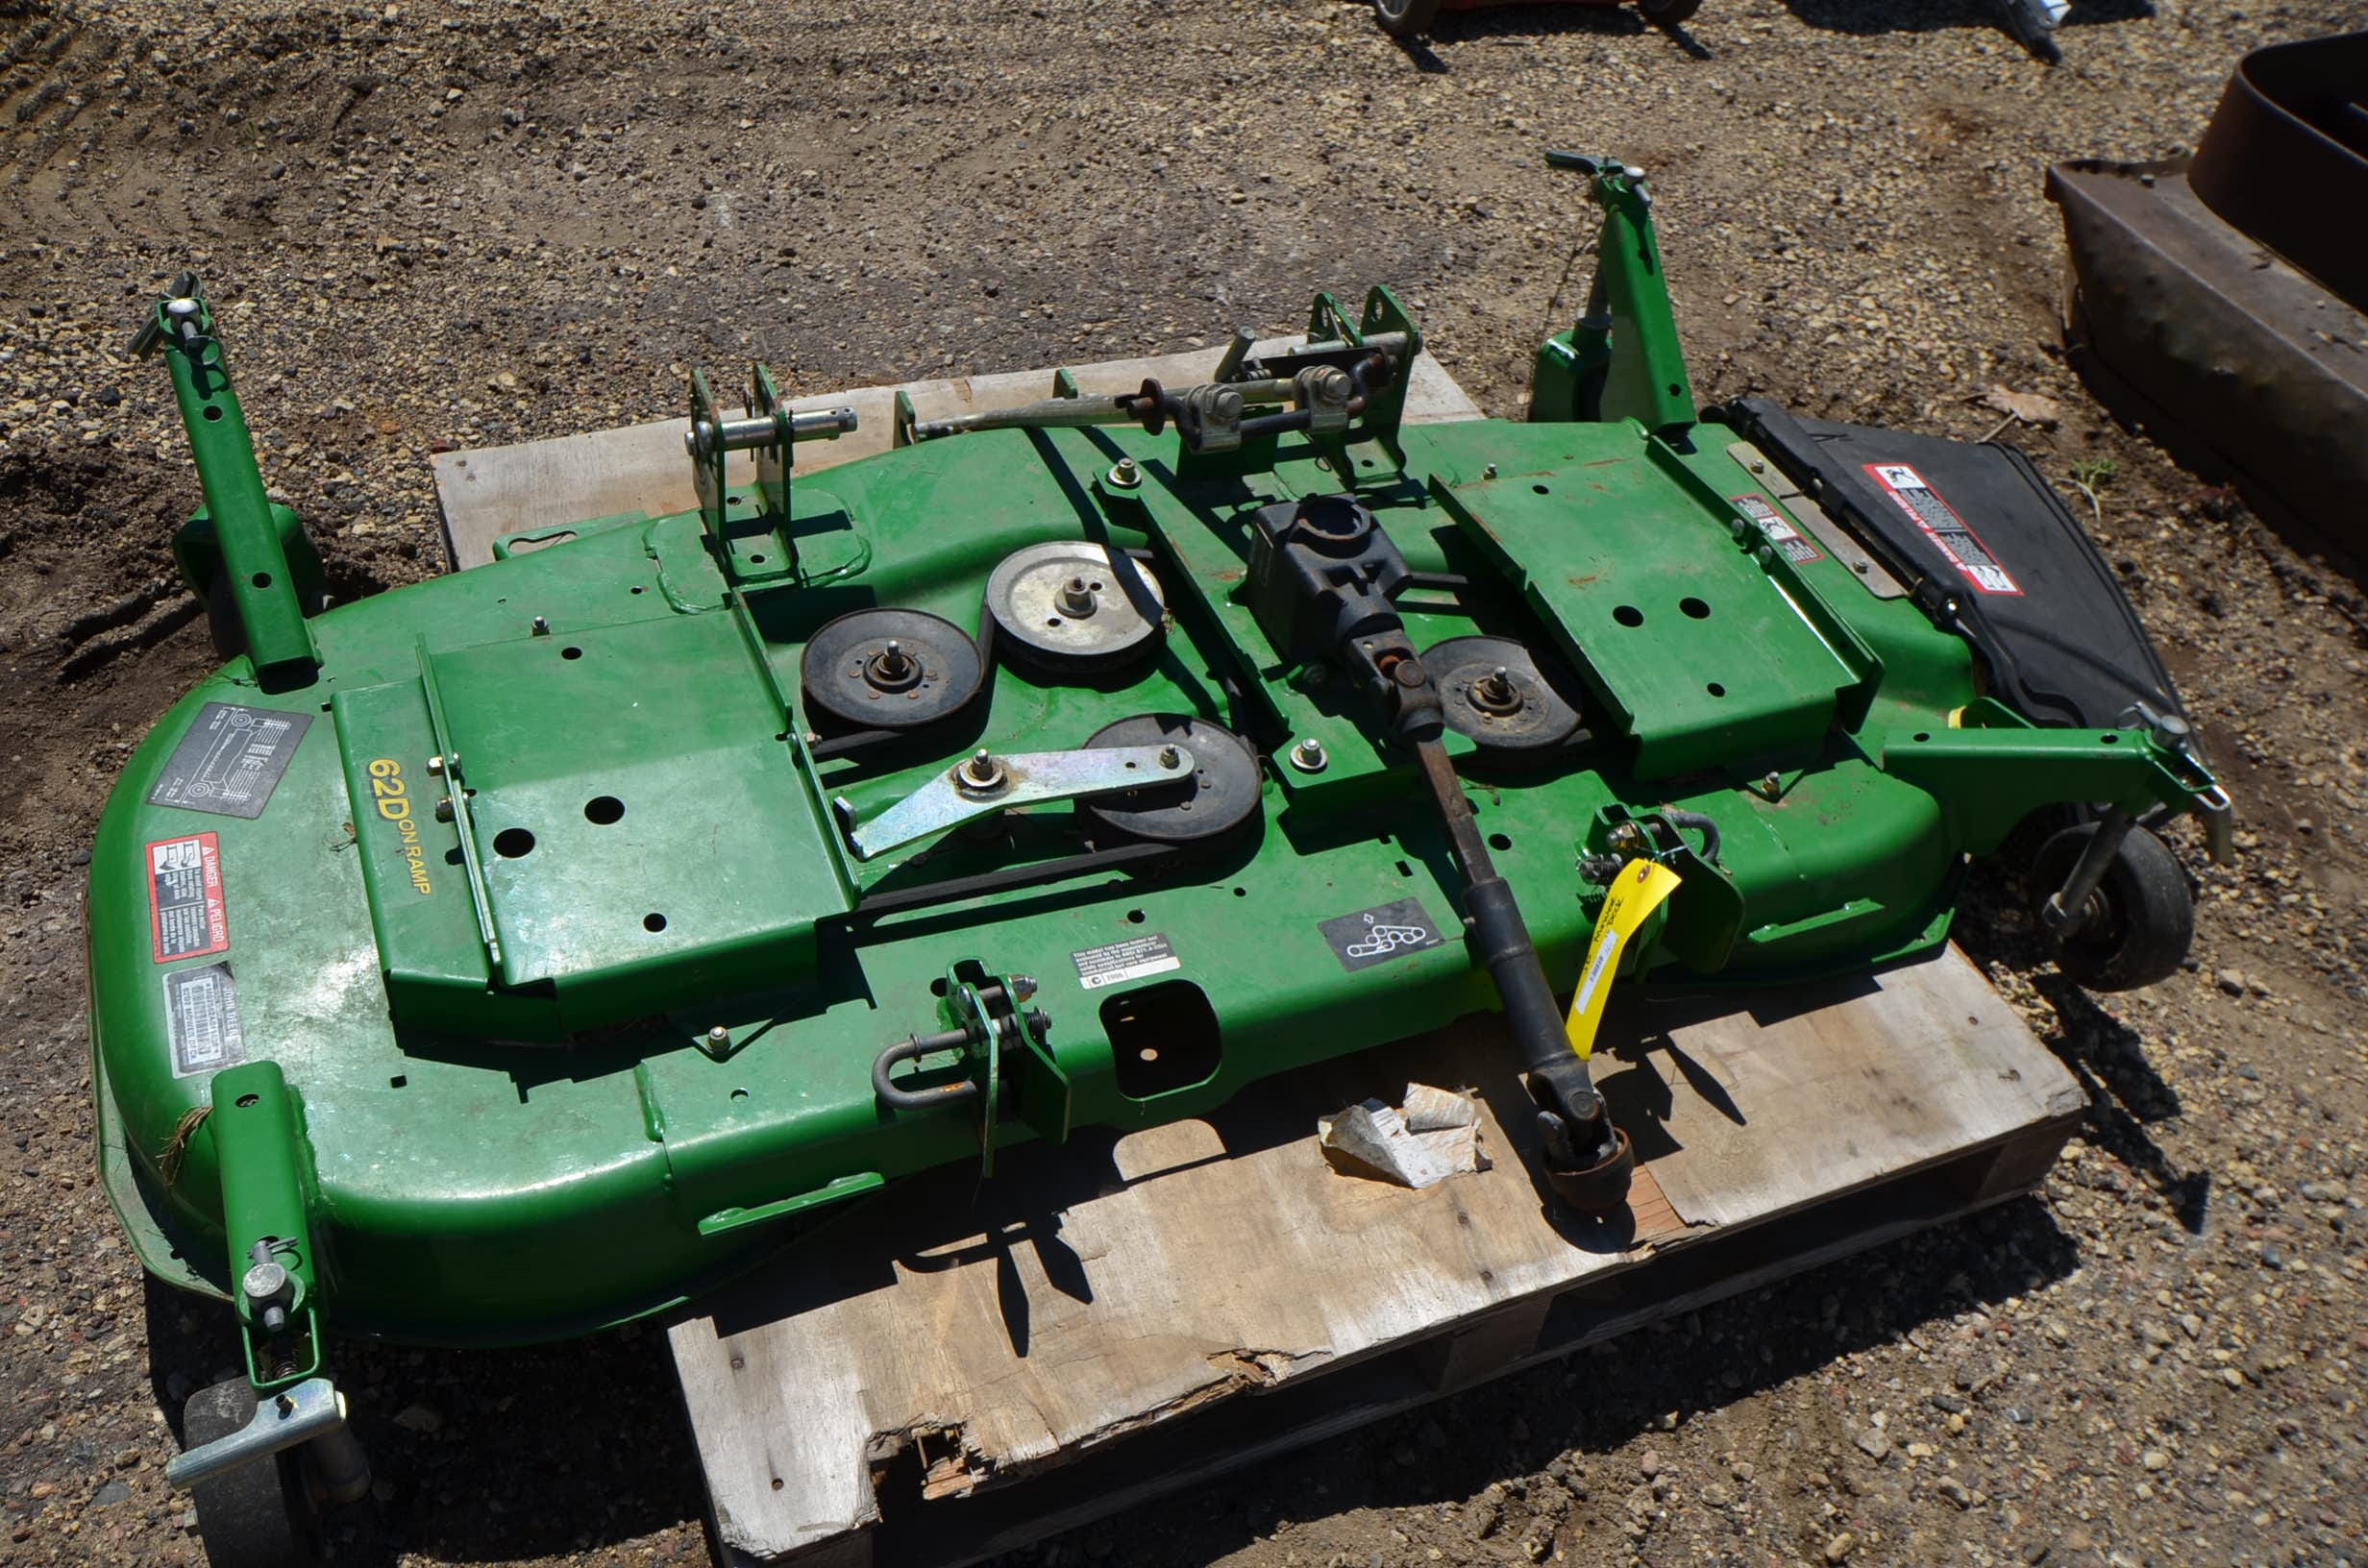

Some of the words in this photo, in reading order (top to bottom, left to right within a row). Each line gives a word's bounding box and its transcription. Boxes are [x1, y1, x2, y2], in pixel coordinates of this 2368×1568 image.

[368, 757, 410, 821] 62D
[398, 819, 419, 844] ON
[204, 855, 218, 888] DANGER
[405, 845, 432, 894] RAMP
[210, 908, 224, 943] PELIGRO
[222, 985, 235, 1010] JOHN
